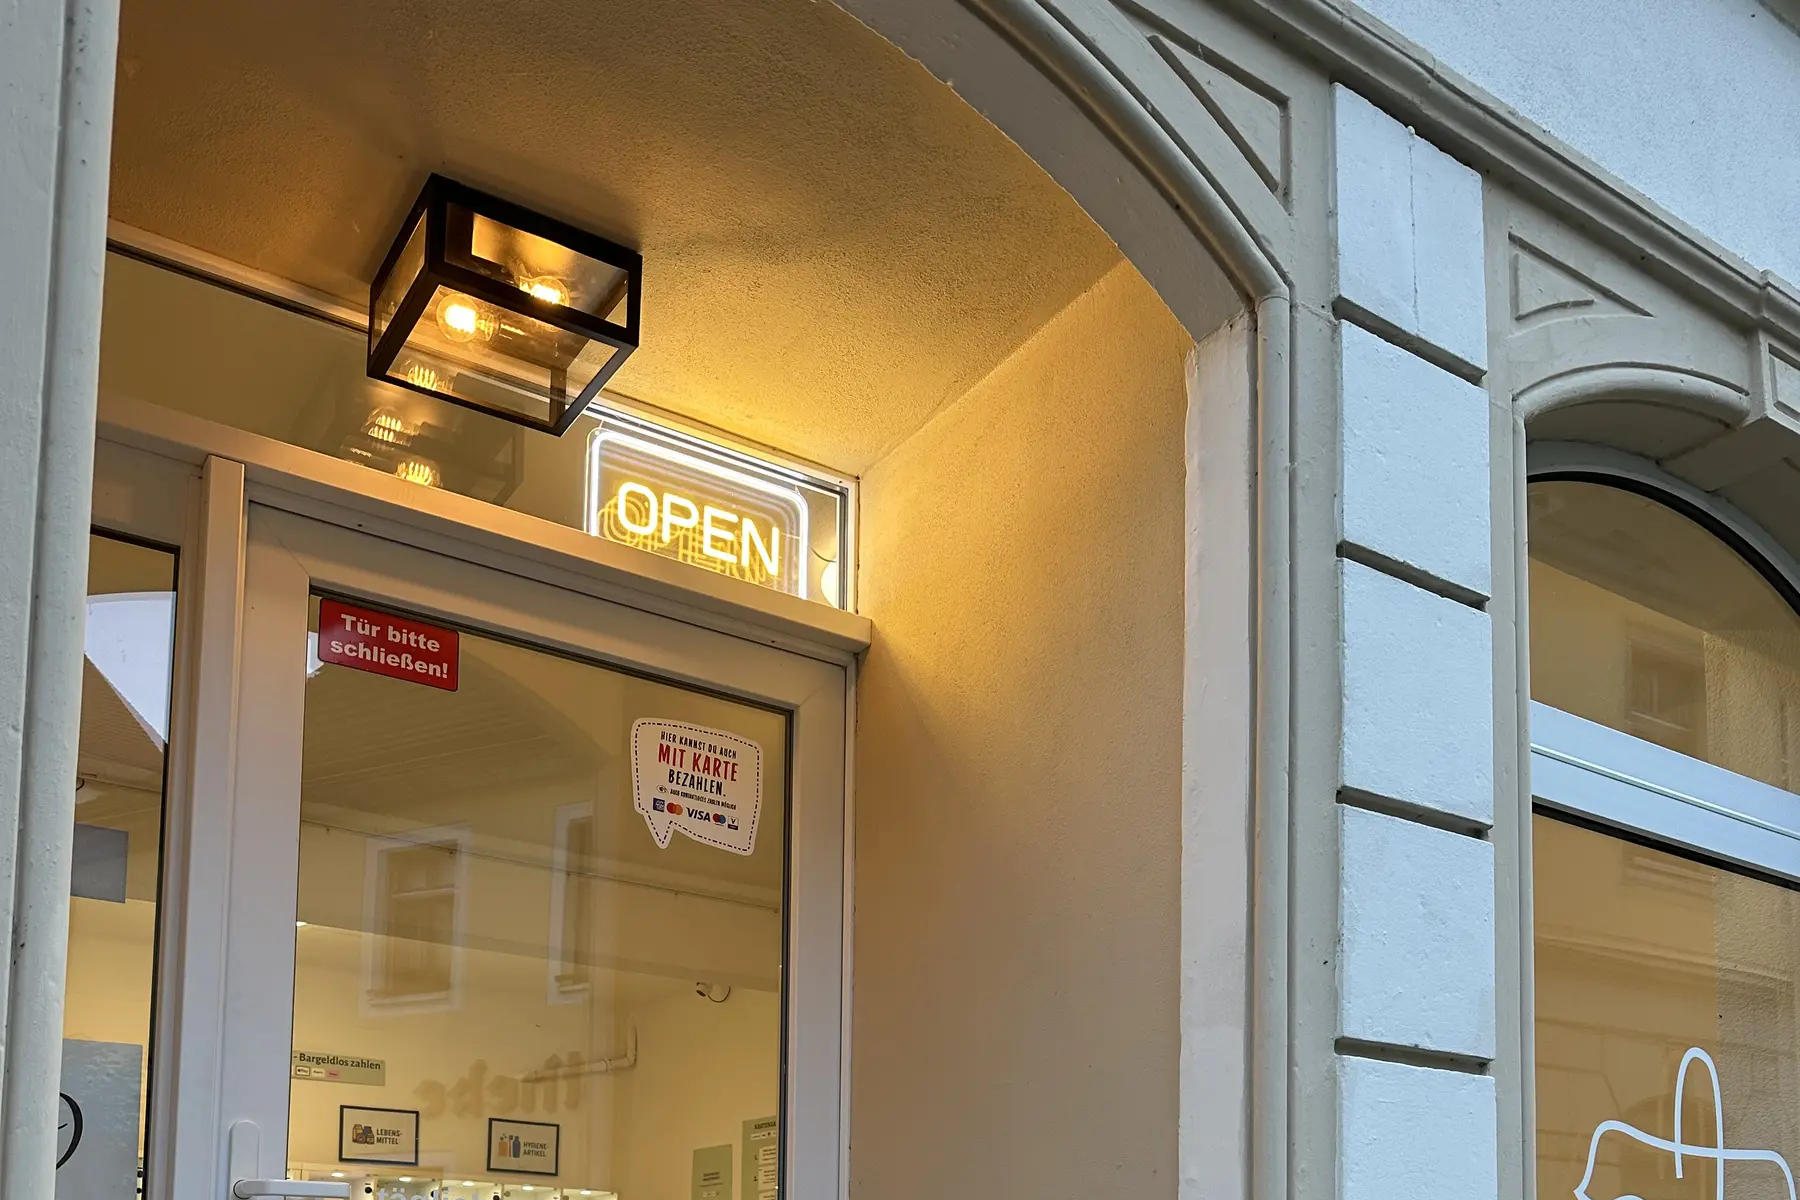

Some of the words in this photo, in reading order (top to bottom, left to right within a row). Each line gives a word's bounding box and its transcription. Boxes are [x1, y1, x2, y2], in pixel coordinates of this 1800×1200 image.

[617, 481, 780, 577] OPEN
[341, 613, 382, 639] Tür
[387, 624, 441, 653] bitte
[330, 639, 449, 680] schließen!
[661, 731, 677, 743] HIER
[679, 736, 706, 751] KANNST
[708, 744, 718, 754] DU
[719, 747, 737, 759] AUCH
[658, 743, 686, 768] MIT
[692, 752, 739, 782] KARTE
[669, 769, 726, 797] BEZAHLEN.
[686, 807, 711, 823] VISA
[299, 1053, 349, 1067] Bargeldlos
[350, 1059, 381, 1070] zahlen
[376, 1128, 403, 1138] LEBENS-
[376, 1136, 399, 1145] MITTEL
[523, 1148, 547, 1157] ARTIKEL
